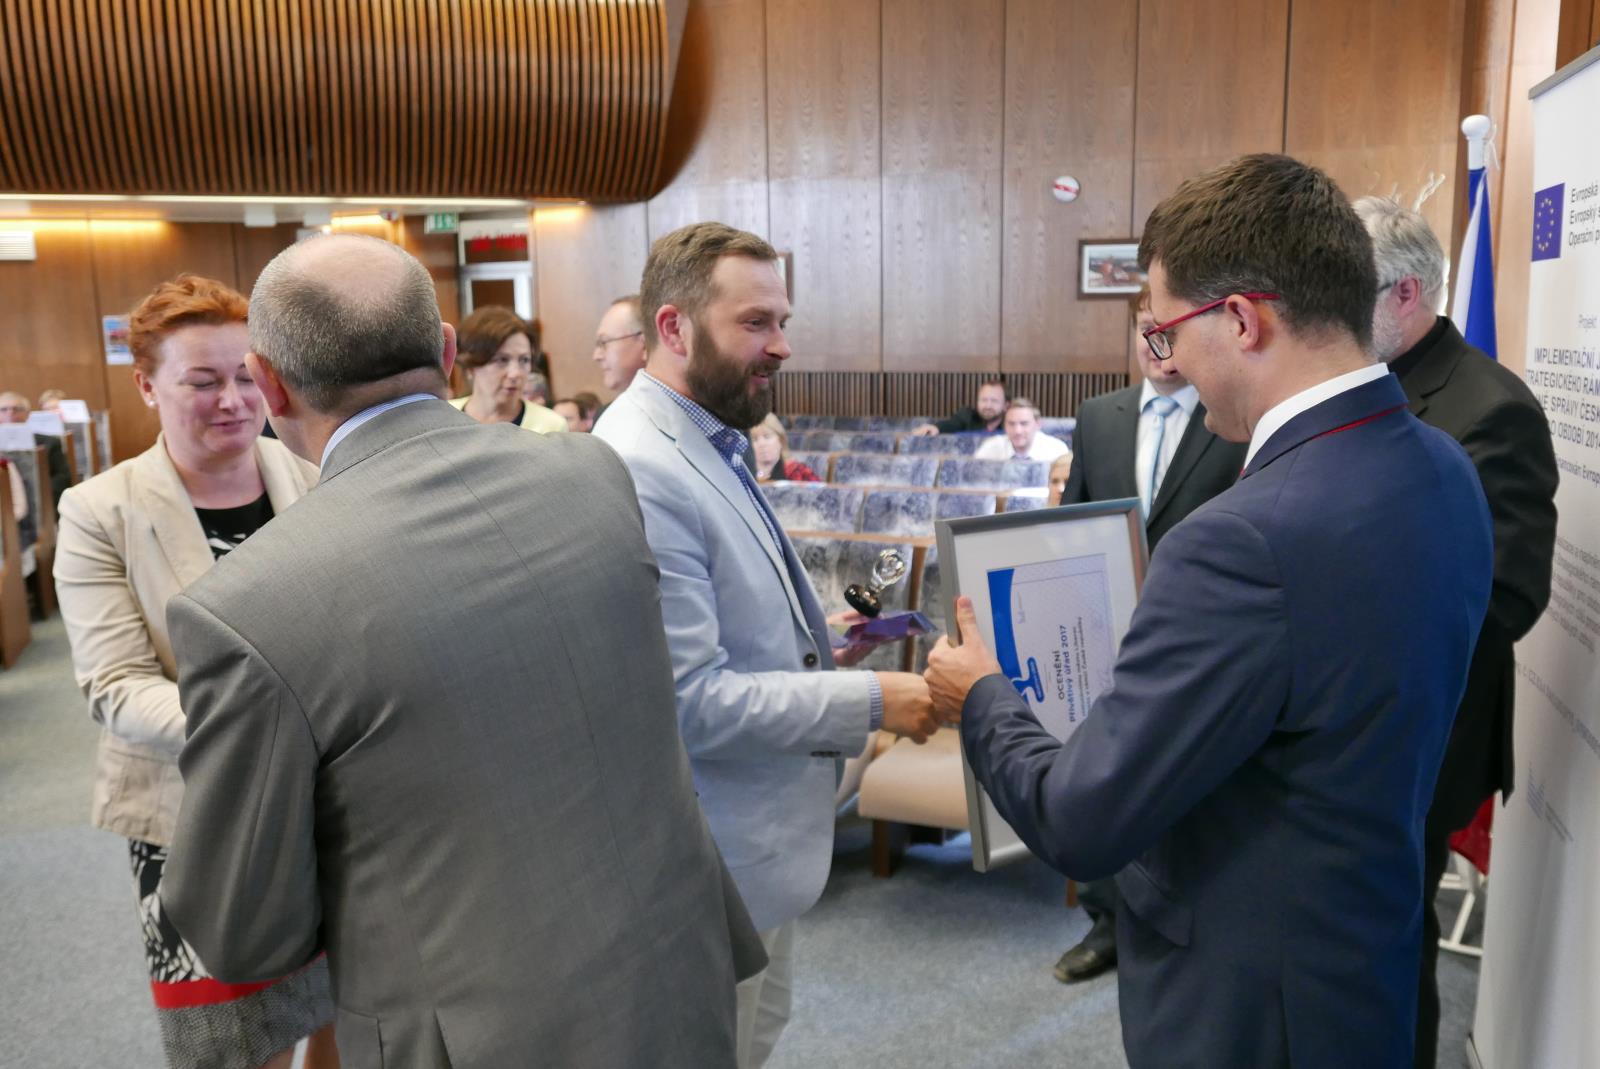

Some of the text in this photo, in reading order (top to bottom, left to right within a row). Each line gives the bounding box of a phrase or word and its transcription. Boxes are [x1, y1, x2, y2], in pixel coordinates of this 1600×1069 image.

[1534, 346, 1595, 369] IMPLEMENTAČNÍ
[1525, 368, 1582, 393] TRATEGICKÉHO
[1059, 625, 1069, 648] 2017
[1052, 650, 1065, 701] OCENĚNÍ
